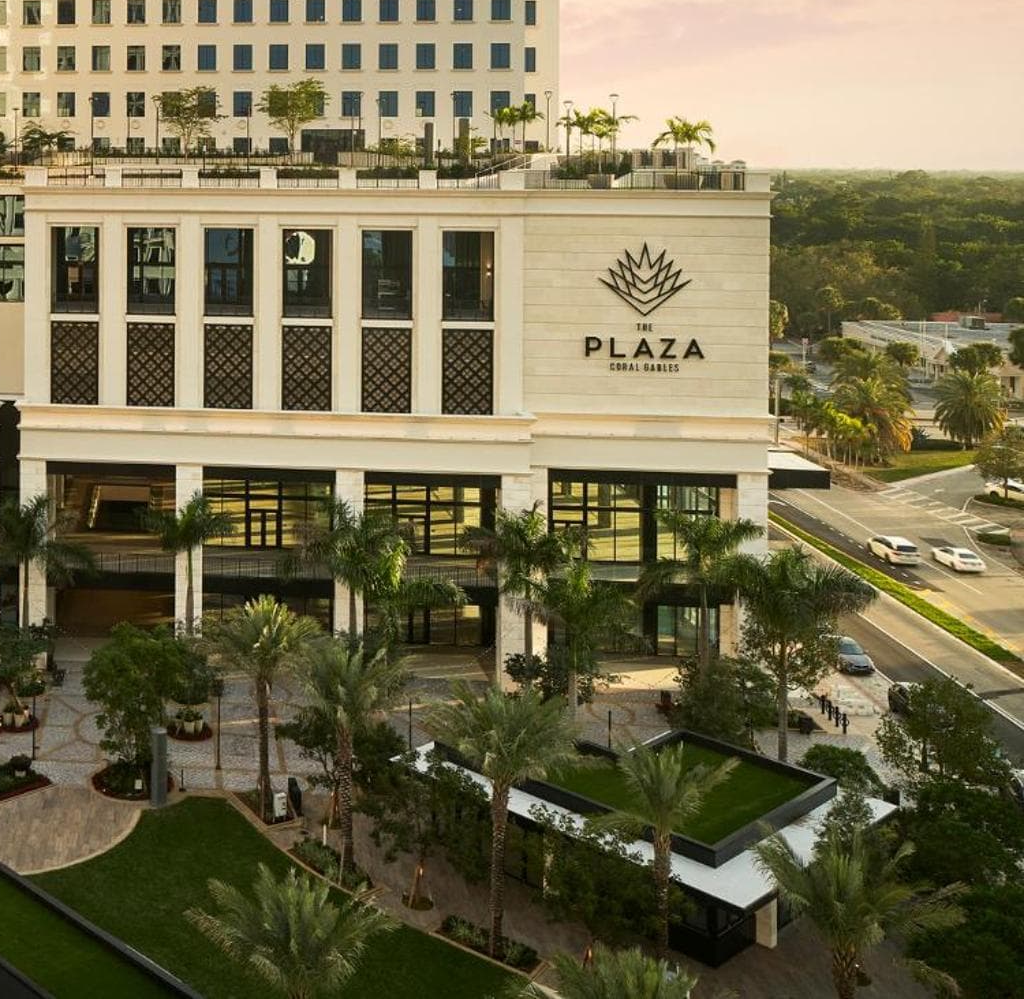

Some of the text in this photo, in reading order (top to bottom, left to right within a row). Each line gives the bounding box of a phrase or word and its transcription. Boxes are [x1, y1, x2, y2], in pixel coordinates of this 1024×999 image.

[636, 322, 654, 332] THE
[584, 336, 705, 360] PLAZA
[609, 362, 680, 373] CORAL GABLES
